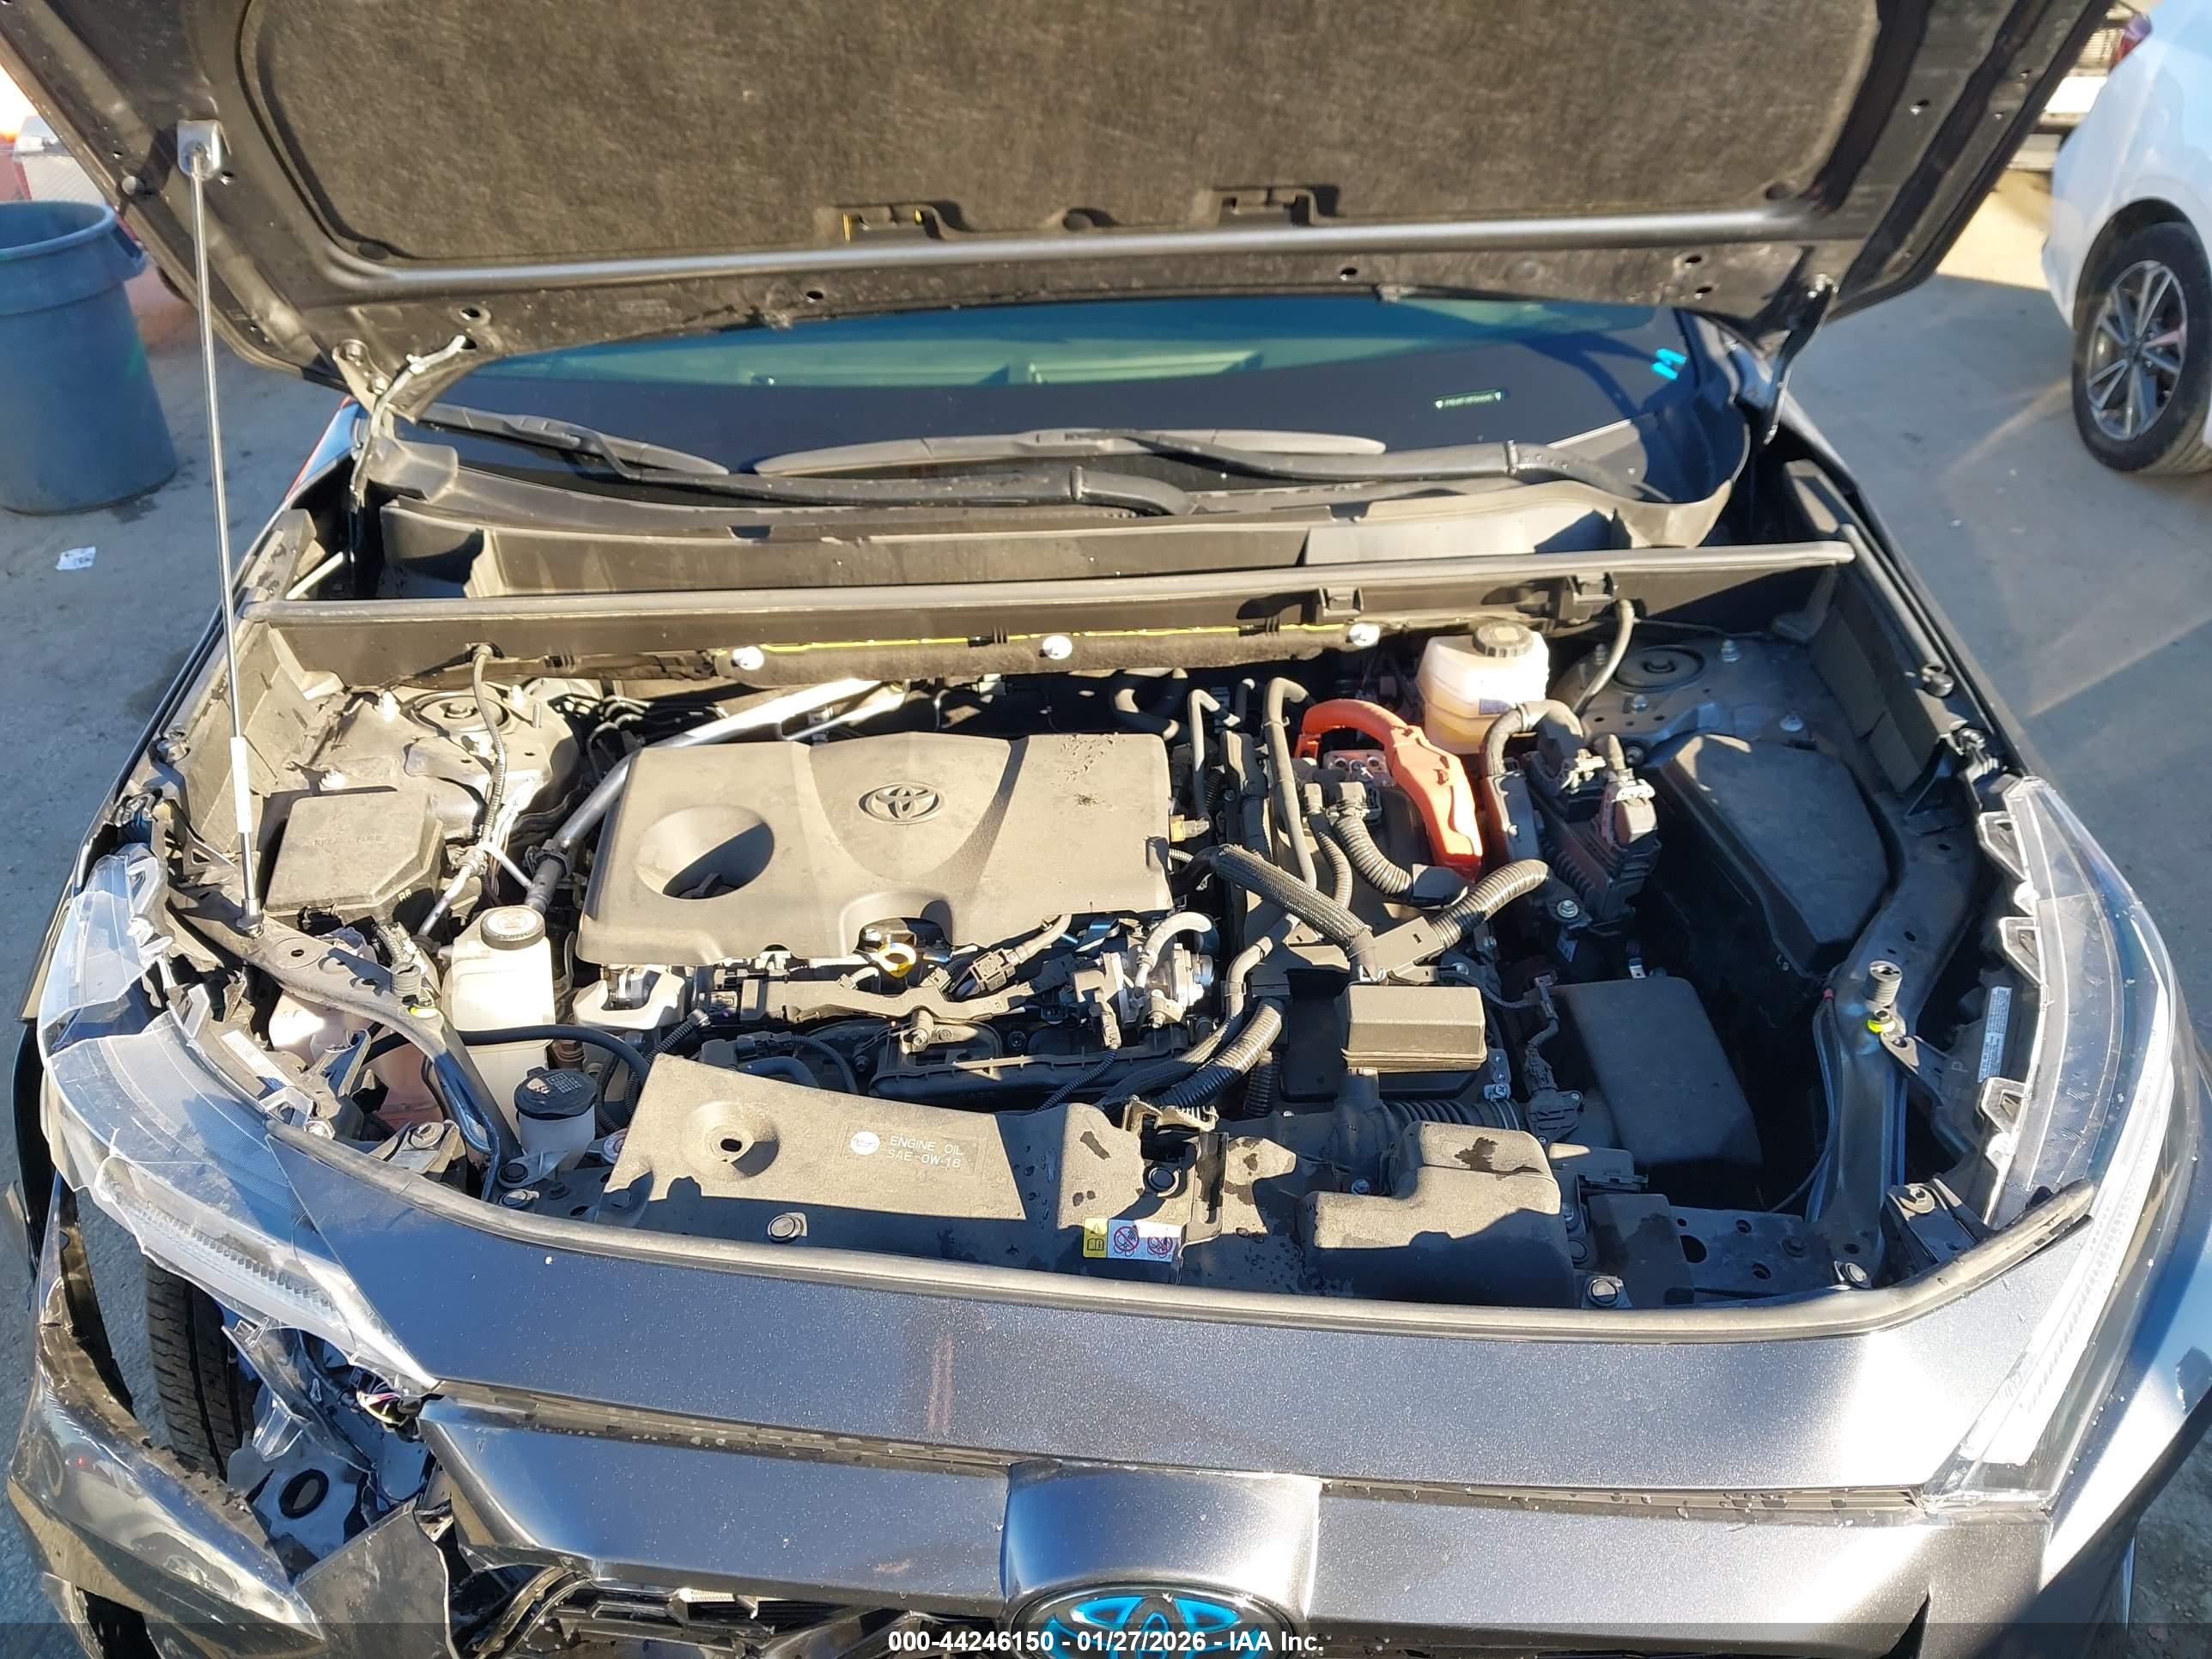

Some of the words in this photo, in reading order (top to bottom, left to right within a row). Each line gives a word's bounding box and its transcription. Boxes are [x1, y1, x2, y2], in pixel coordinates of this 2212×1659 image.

[890, 1136, 936, 1152] ENGINE
[944, 1145, 963, 1156] OIL
[887, 1149, 913, 1162] SAE
